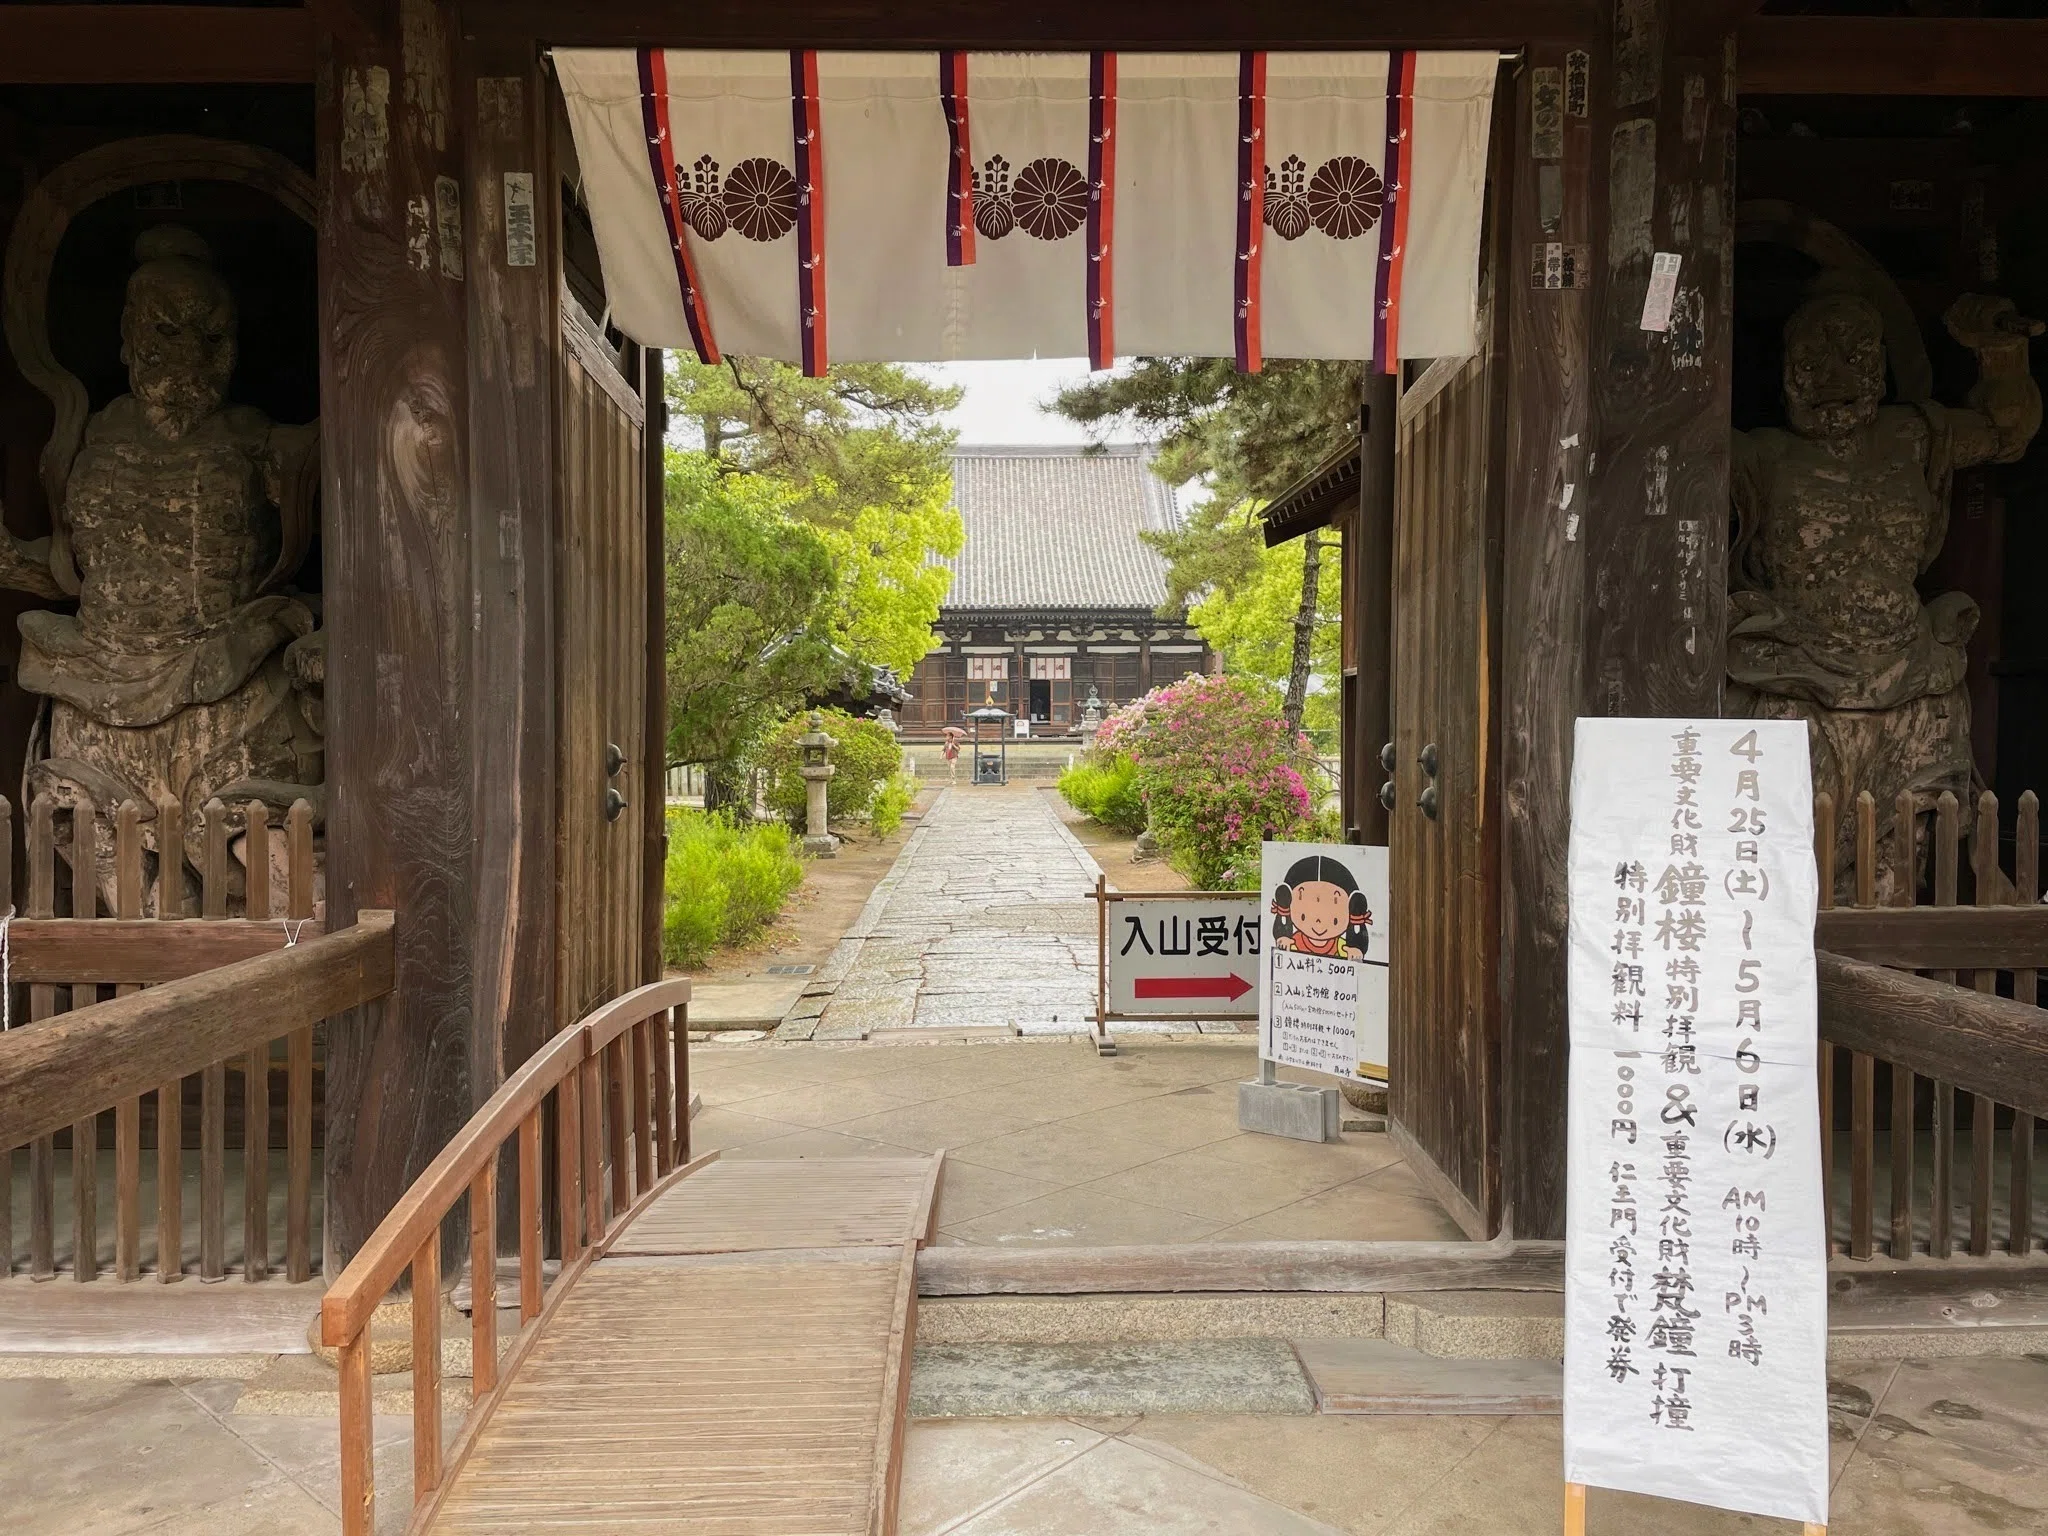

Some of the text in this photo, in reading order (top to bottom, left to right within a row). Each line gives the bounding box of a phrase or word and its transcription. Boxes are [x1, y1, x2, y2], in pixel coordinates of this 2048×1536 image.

[1121, 915, 1261, 956] 入山受付
[1610, 860, 1648, 1032] 特別拝観料
[1328, 962, 1355, 976] 500円
[1333, 990, 1357, 1002] 800円
[1605, 1161, 1641, 1383] 仁王門受付で発券
